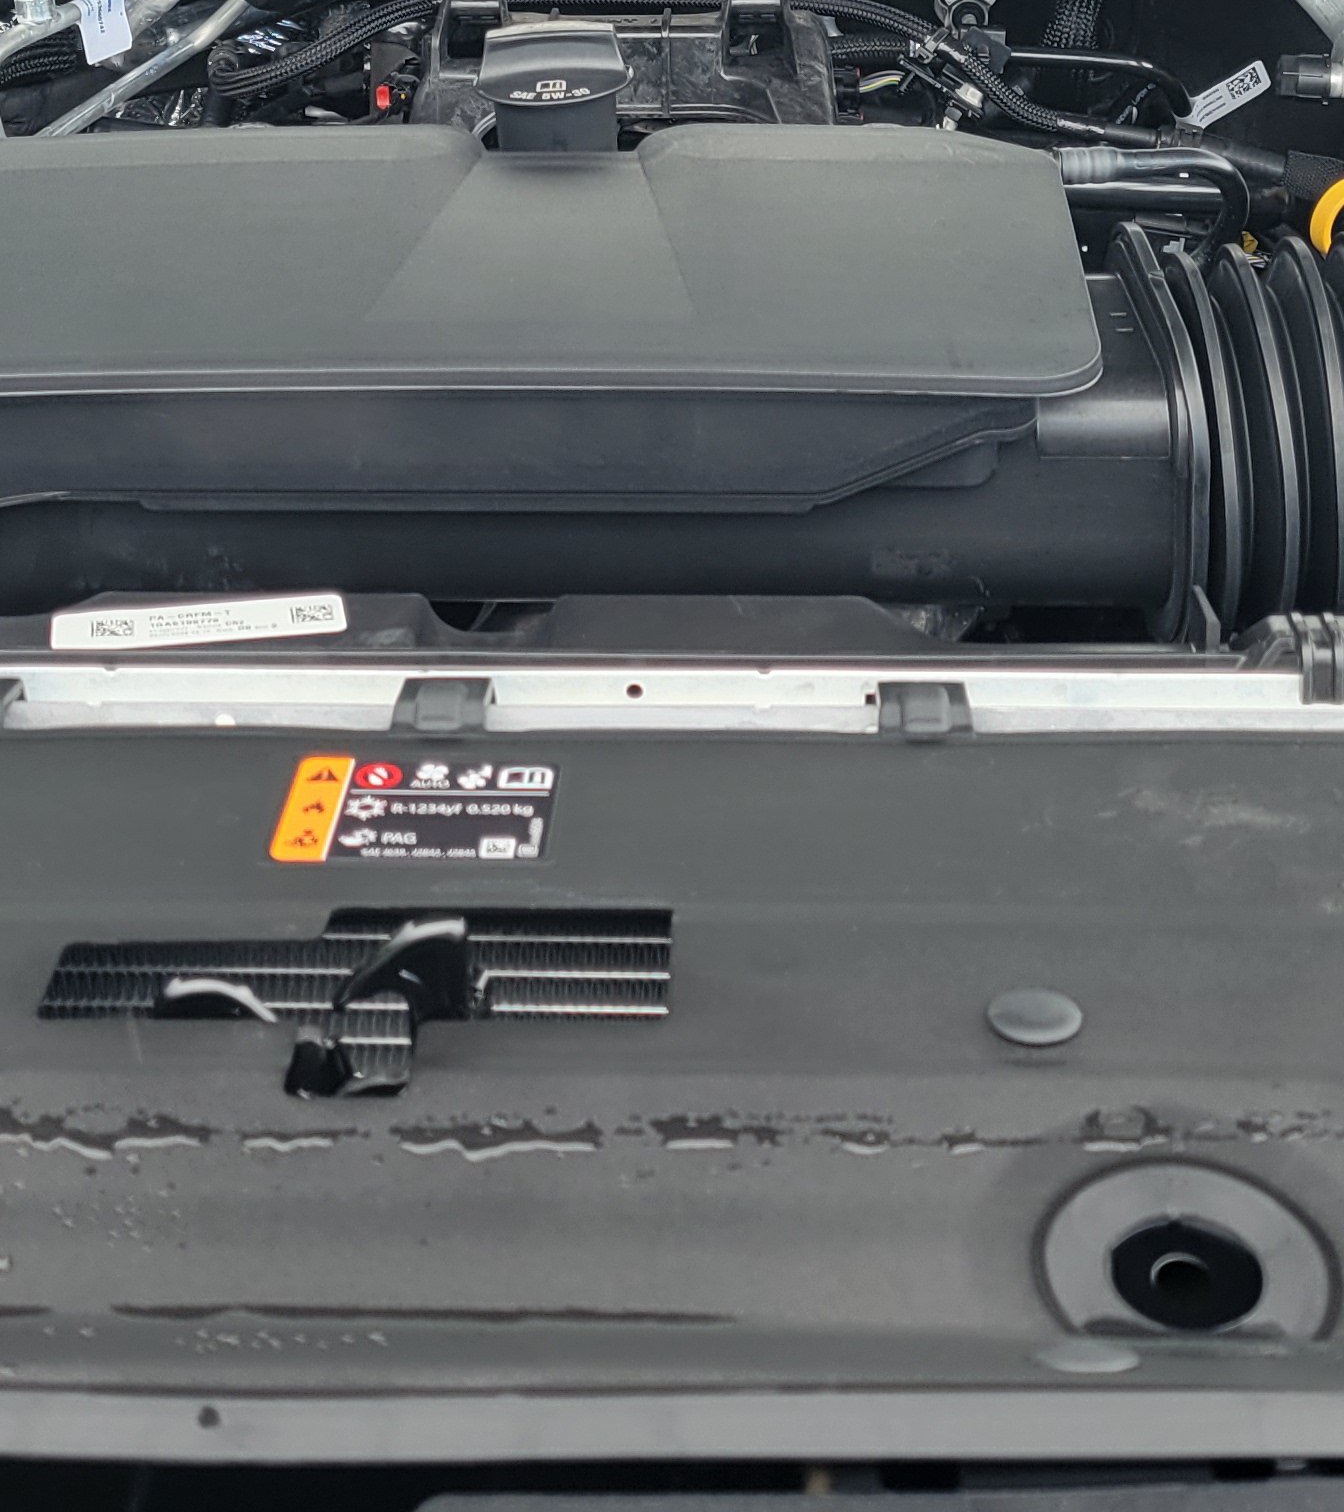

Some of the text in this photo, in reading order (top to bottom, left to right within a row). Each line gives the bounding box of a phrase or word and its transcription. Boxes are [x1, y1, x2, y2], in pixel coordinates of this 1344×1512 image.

[509, 88, 591, 100] SAE 5W-30
[409, 778, 451, 789] AUTO
[391, 802, 535, 818] R-1234yf 0.520 kg
[381, 831, 418, 845] PAG
